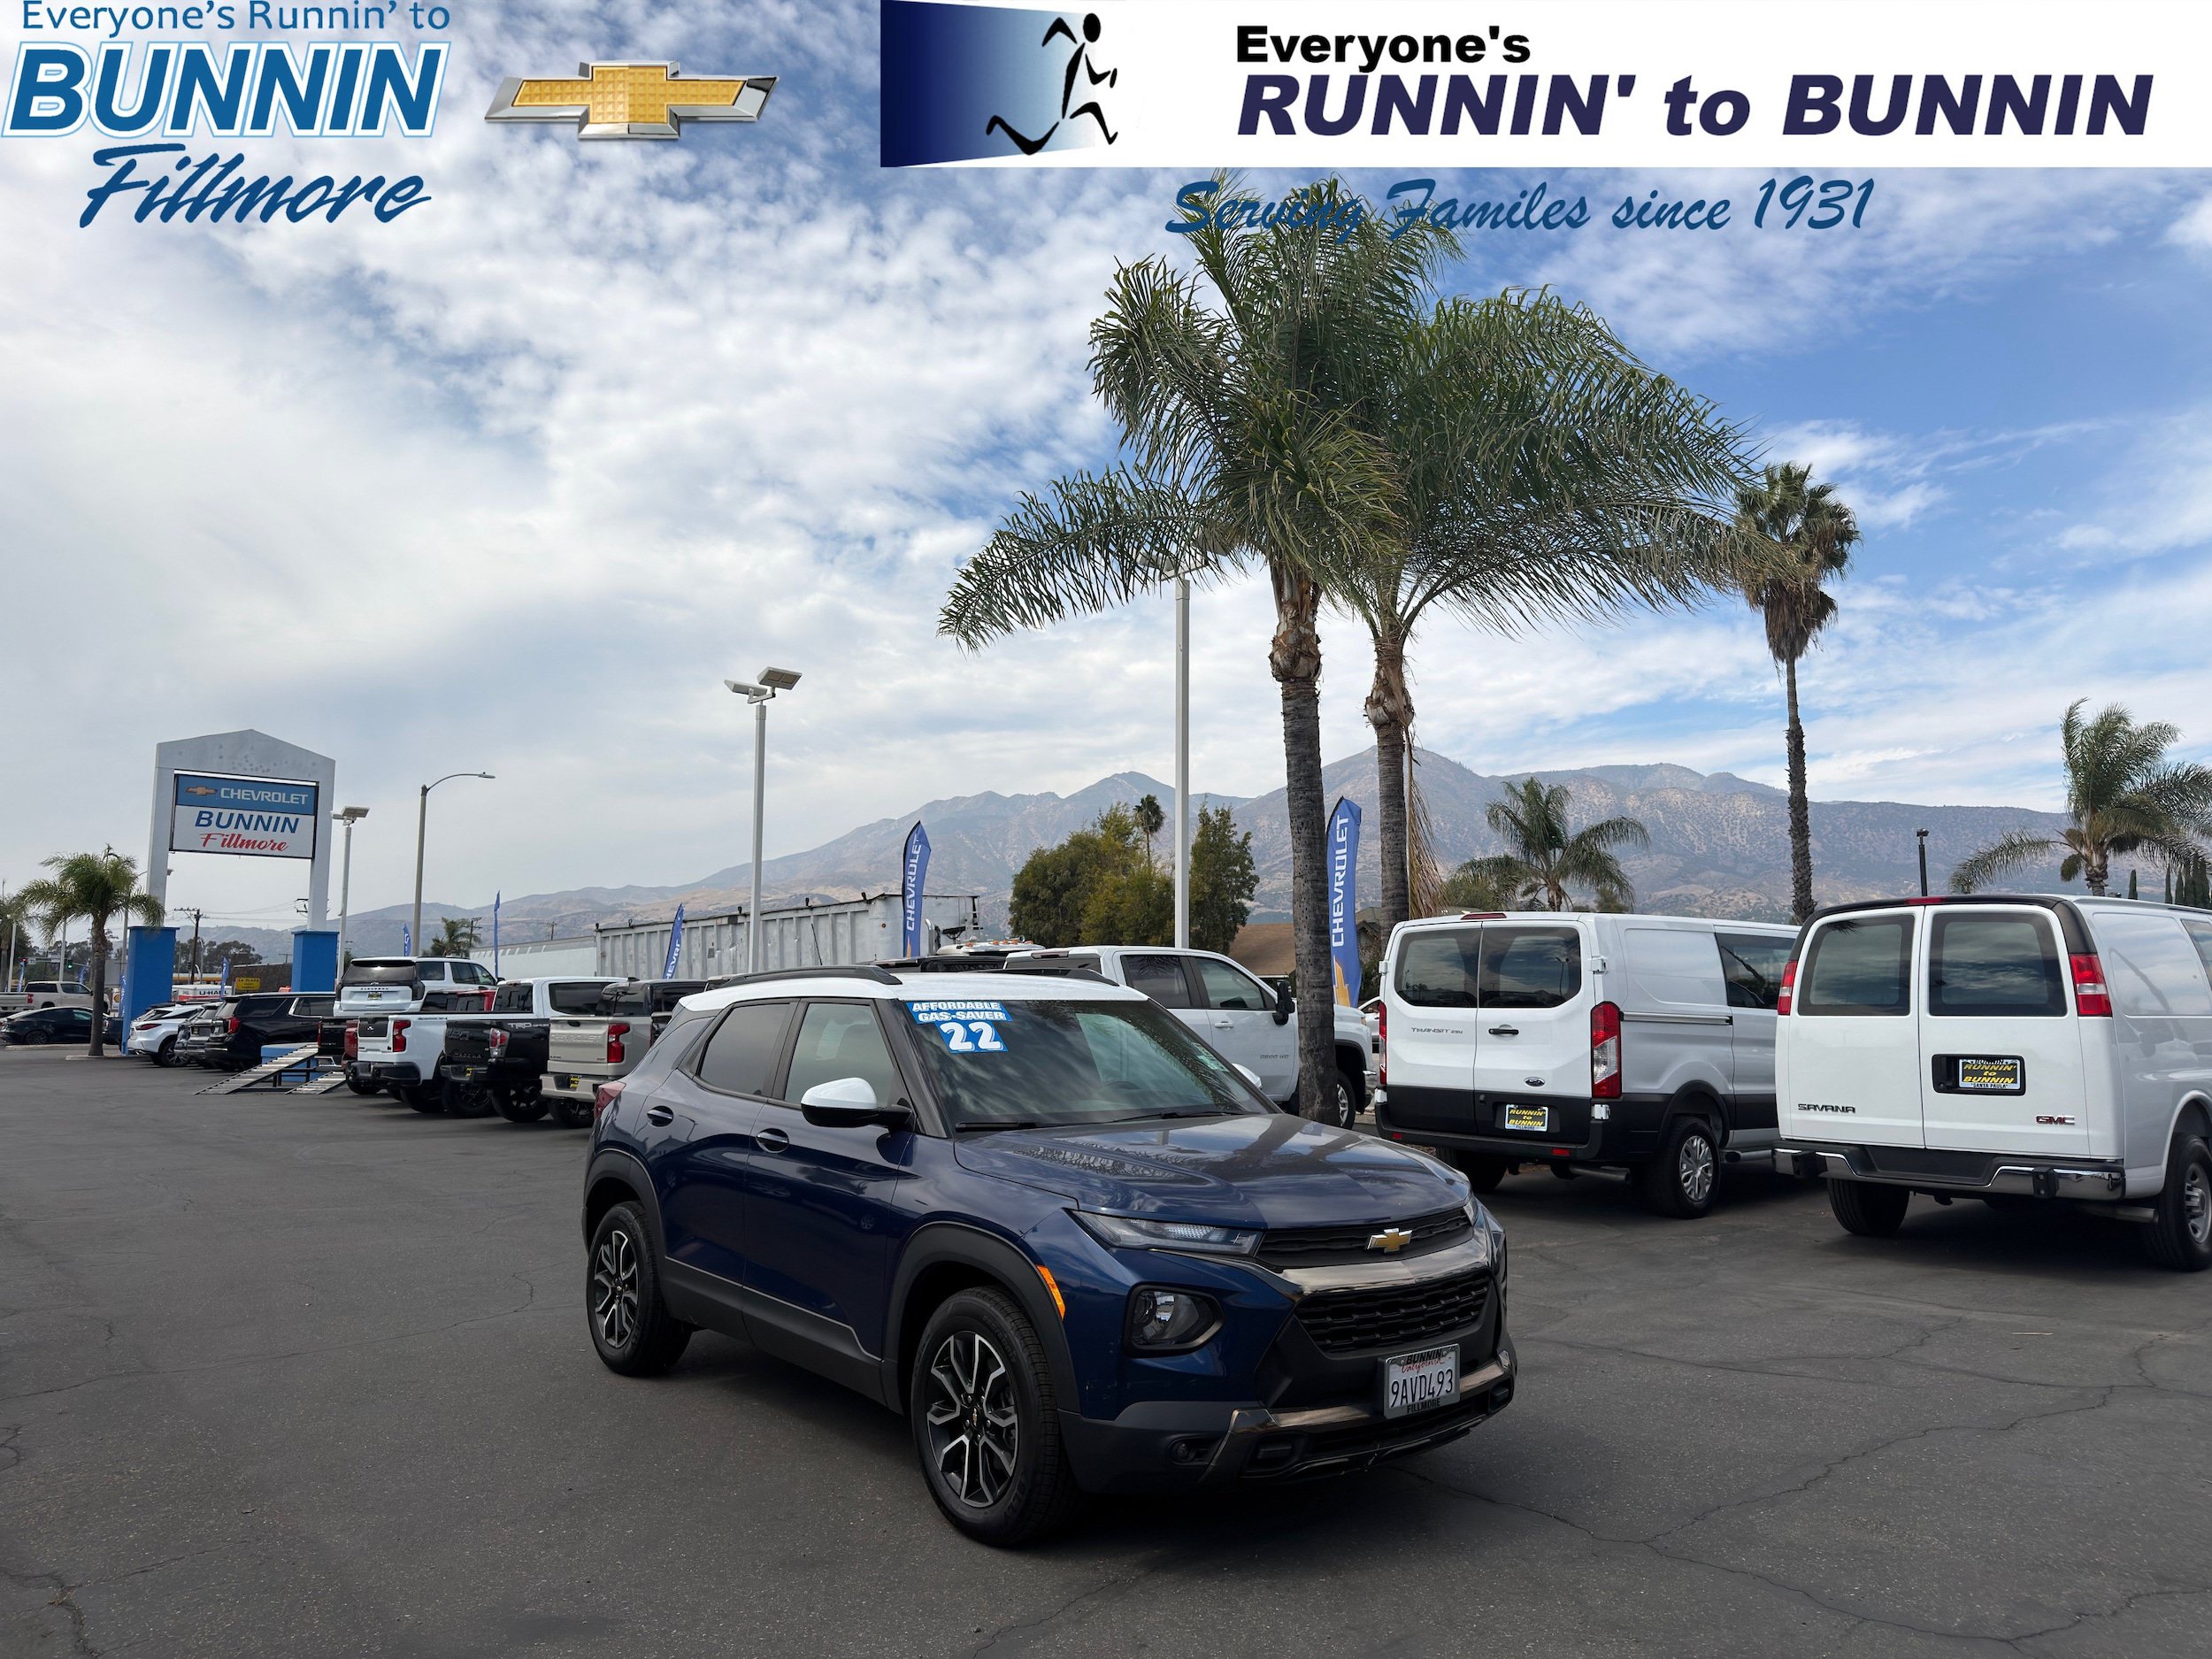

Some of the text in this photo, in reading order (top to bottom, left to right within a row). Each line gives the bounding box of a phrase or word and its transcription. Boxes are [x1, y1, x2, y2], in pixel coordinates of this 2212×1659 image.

[220, 787, 309, 805] CHEVROLET
[195, 810, 299, 833] BUNNIN
[200, 833, 289, 852] Fillmore
[906, 834, 922, 932] CHEVROLET
[1332, 815, 1349, 948] CHEVROLET
[912, 1002, 1002, 1011] AFFORDABLE
[918, 1010, 1008, 1022] GAS-SAVER
[940, 1021, 1004, 1051] 22
[1798, 1103, 1856, 1114] SAVANA
[2036, 1115, 2076, 1125] GMC
[1406, 1348, 1442, 1365] BUNNIN
[1391, 1368, 1453, 1409] 9AVD493
[1407, 1398, 1441, 1415] FILLMORE
